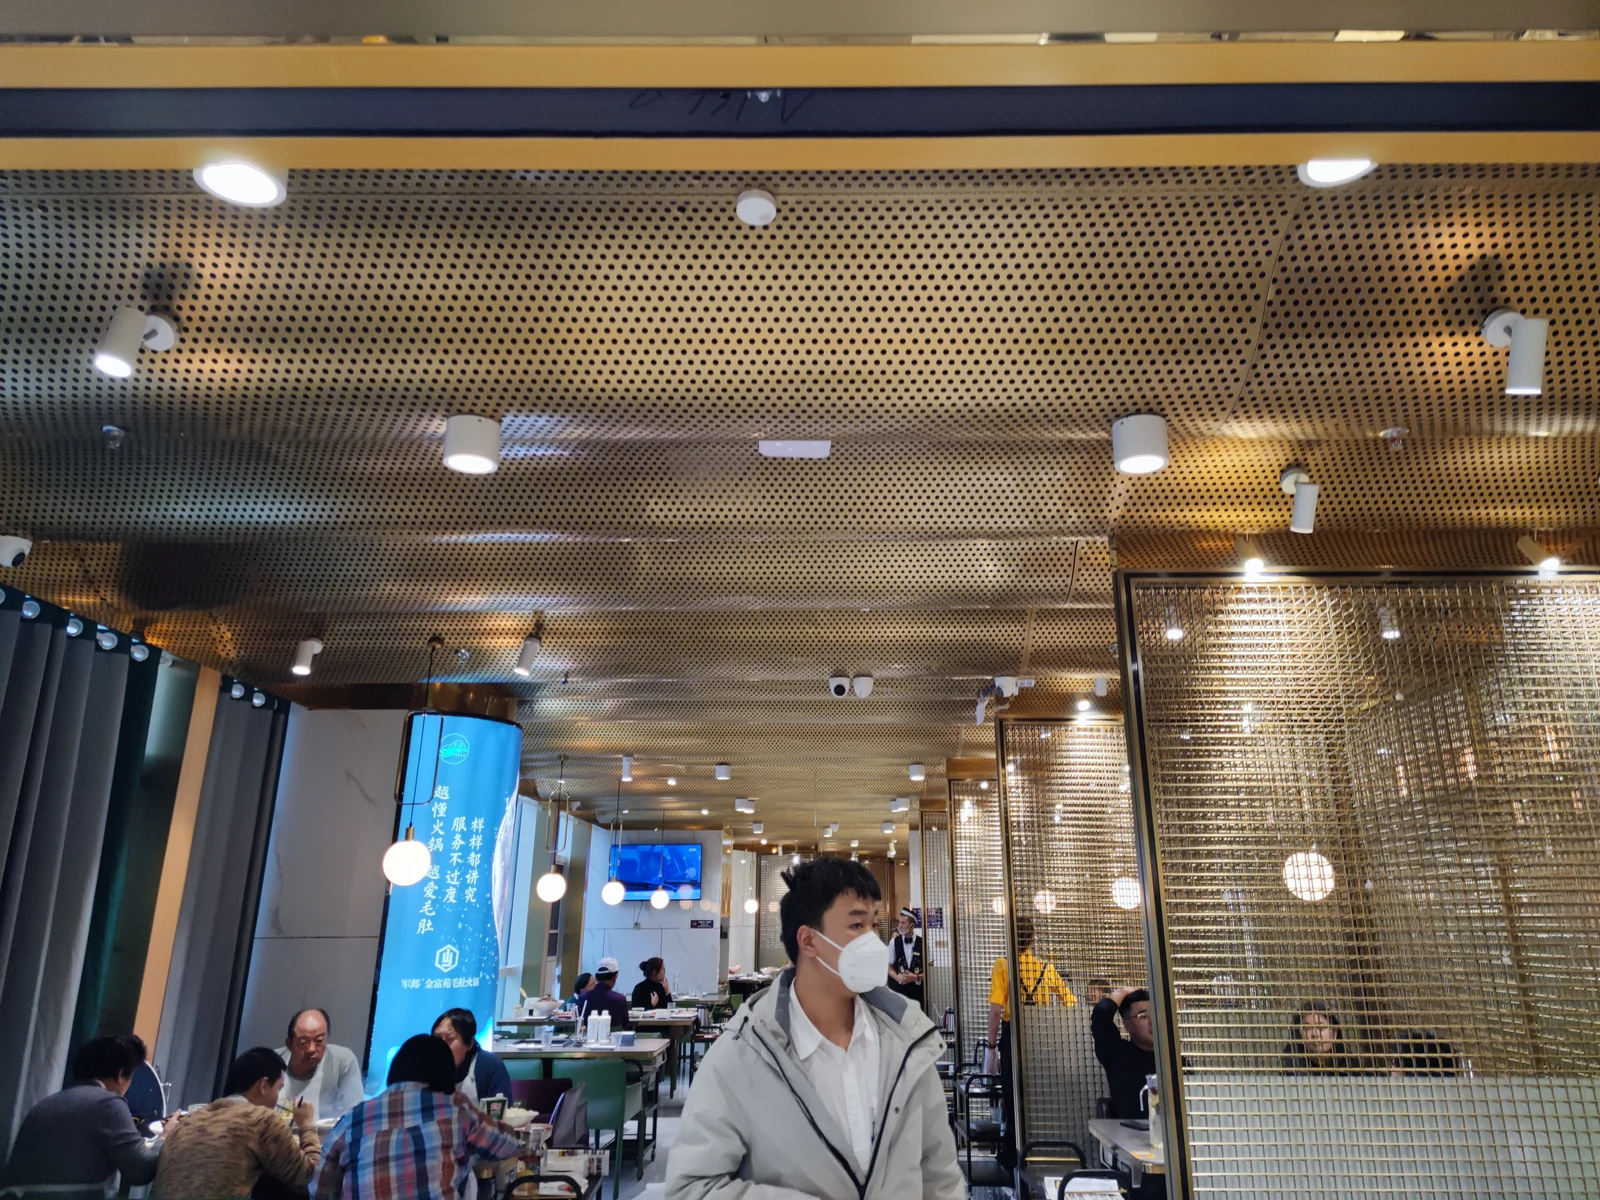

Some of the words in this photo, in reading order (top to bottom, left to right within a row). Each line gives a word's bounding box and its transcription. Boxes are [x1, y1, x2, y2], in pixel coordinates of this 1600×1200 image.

[428, 785, 450, 852] 越懂火锅
[442, 816, 467, 903] 服务不过度
[465, 817, 485, 903] 样样都讲究
